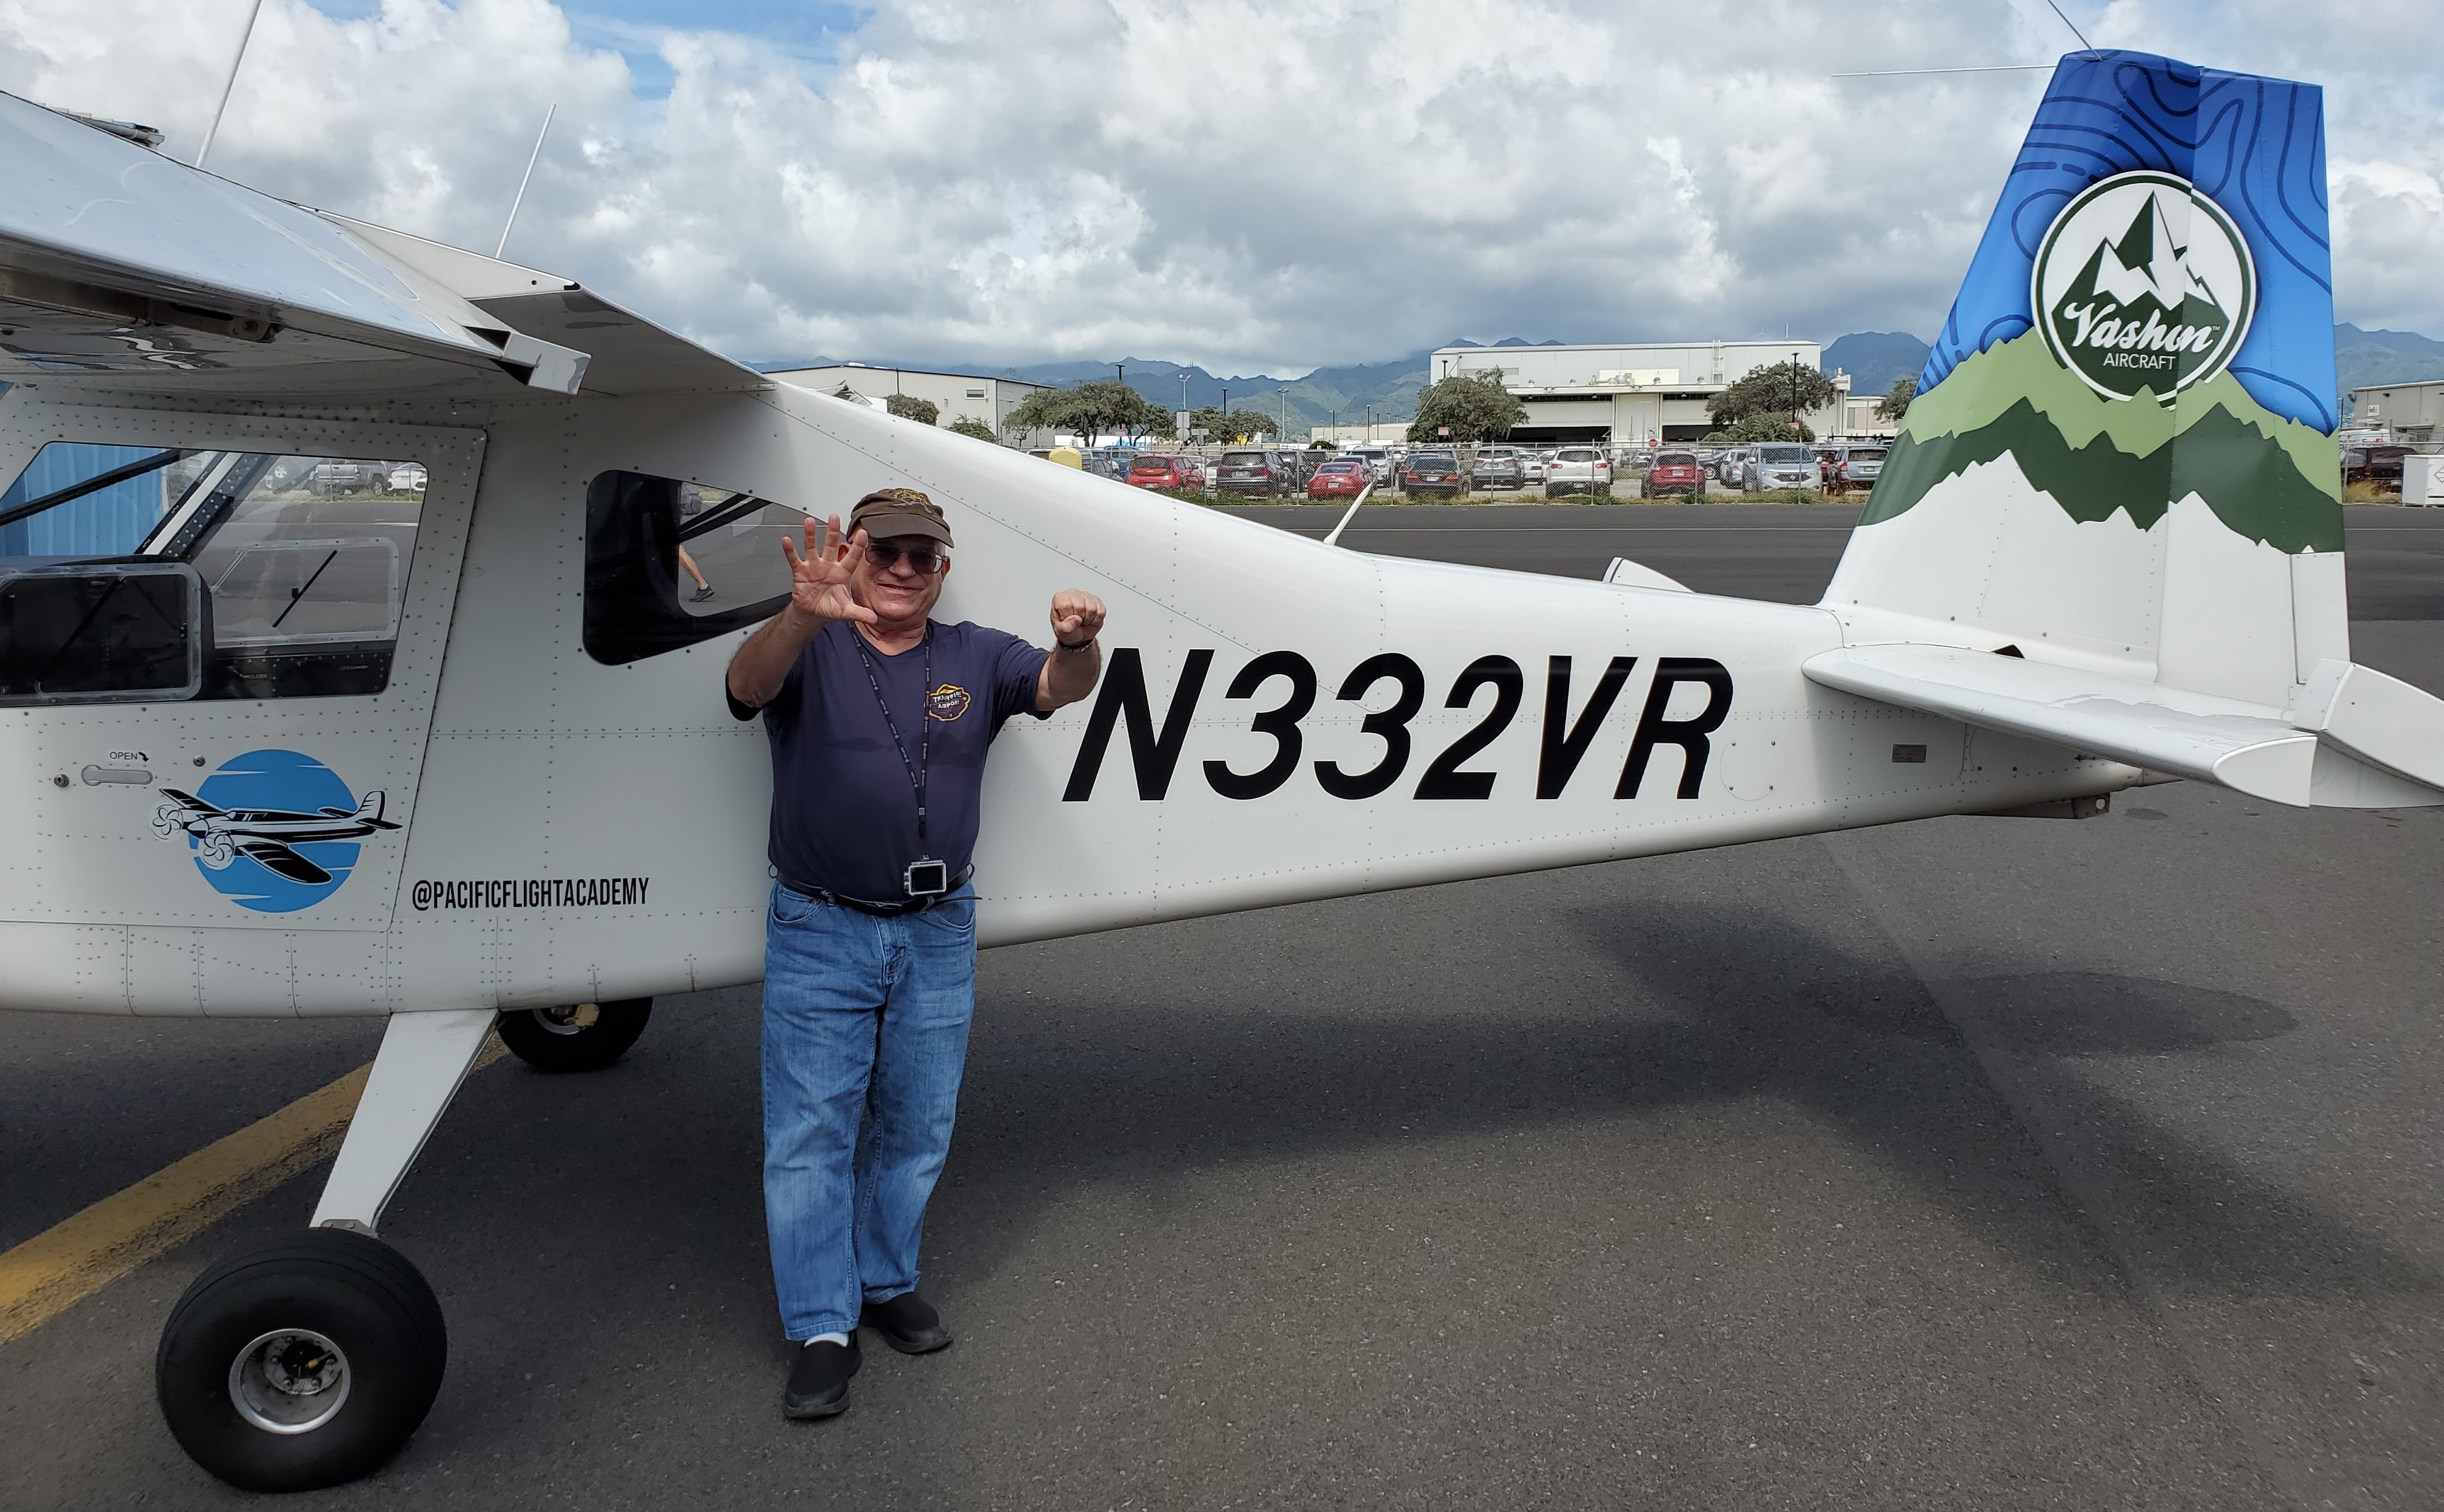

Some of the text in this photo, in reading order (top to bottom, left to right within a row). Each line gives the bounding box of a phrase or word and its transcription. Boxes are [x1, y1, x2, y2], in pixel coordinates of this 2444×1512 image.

[2063, 302, 2213, 352] Vashon
[2102, 353, 2176, 370] AIRCRAFT
[937, 700, 960, 709] AIRPORT
[1061, 647, 1733, 802] N332VR
[110, 751, 138, 760] OPEN
[412, 877, 649, 911] @PACIFICFLIGHTACADEMY
